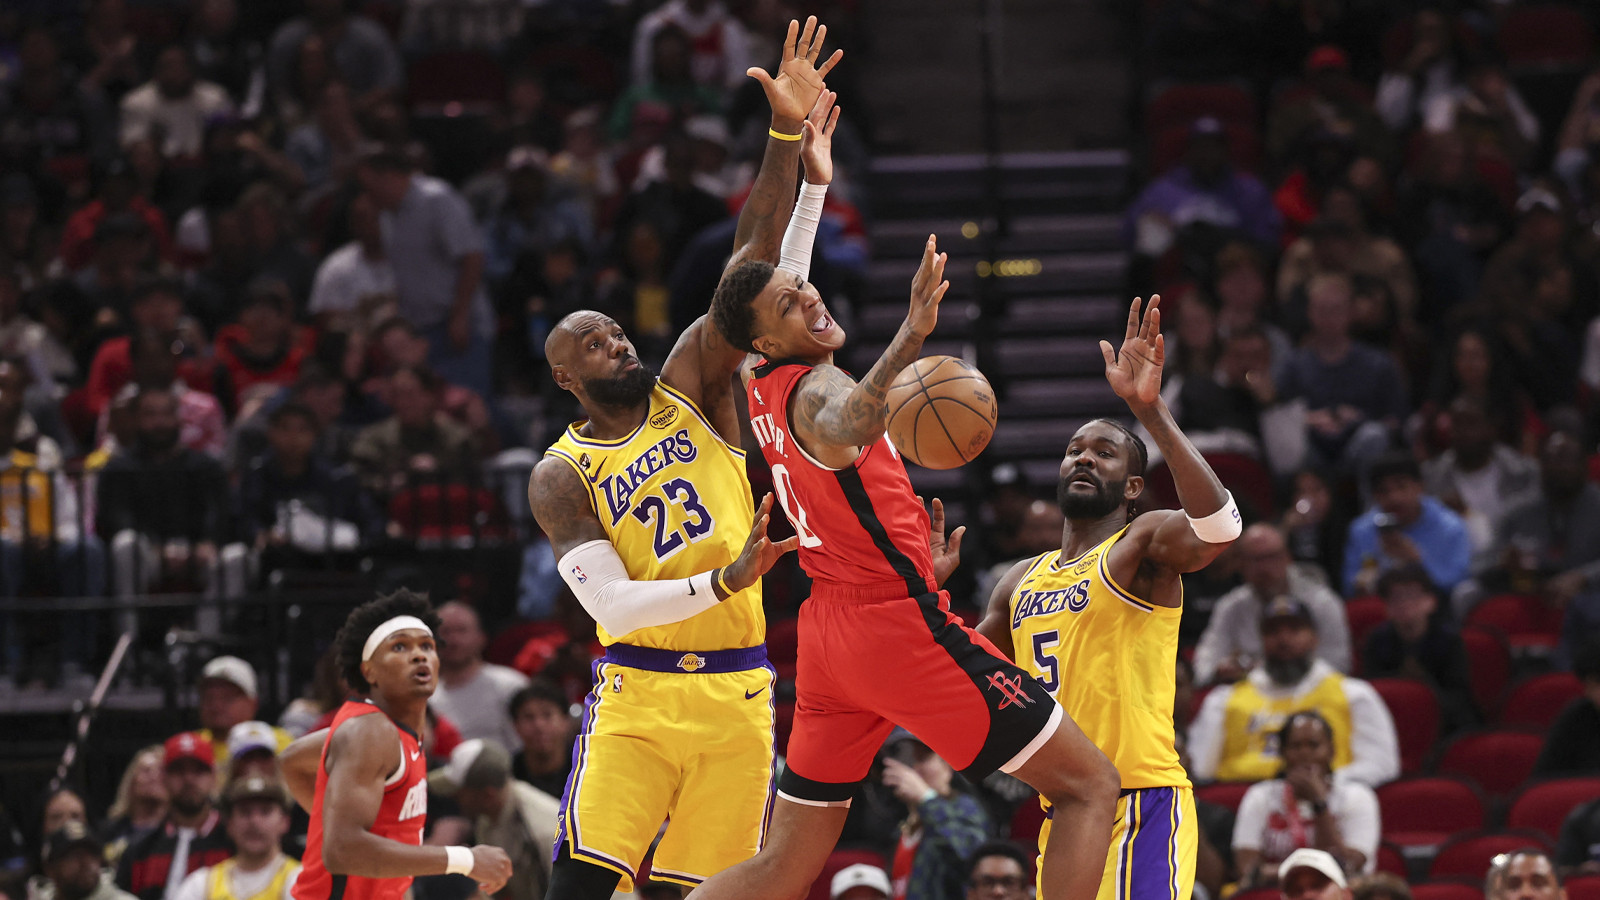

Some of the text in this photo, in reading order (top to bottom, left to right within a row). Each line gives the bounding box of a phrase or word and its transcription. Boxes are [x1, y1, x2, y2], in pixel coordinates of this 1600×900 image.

[651, 407, 677, 426] bibigo
[598, 428, 698, 528] LAKERS
[772, 463, 823, 549] 0
[630, 477, 716, 564] 23
[1012, 579, 1091, 631] LAKERS
[1031, 628, 1061, 698] 5
